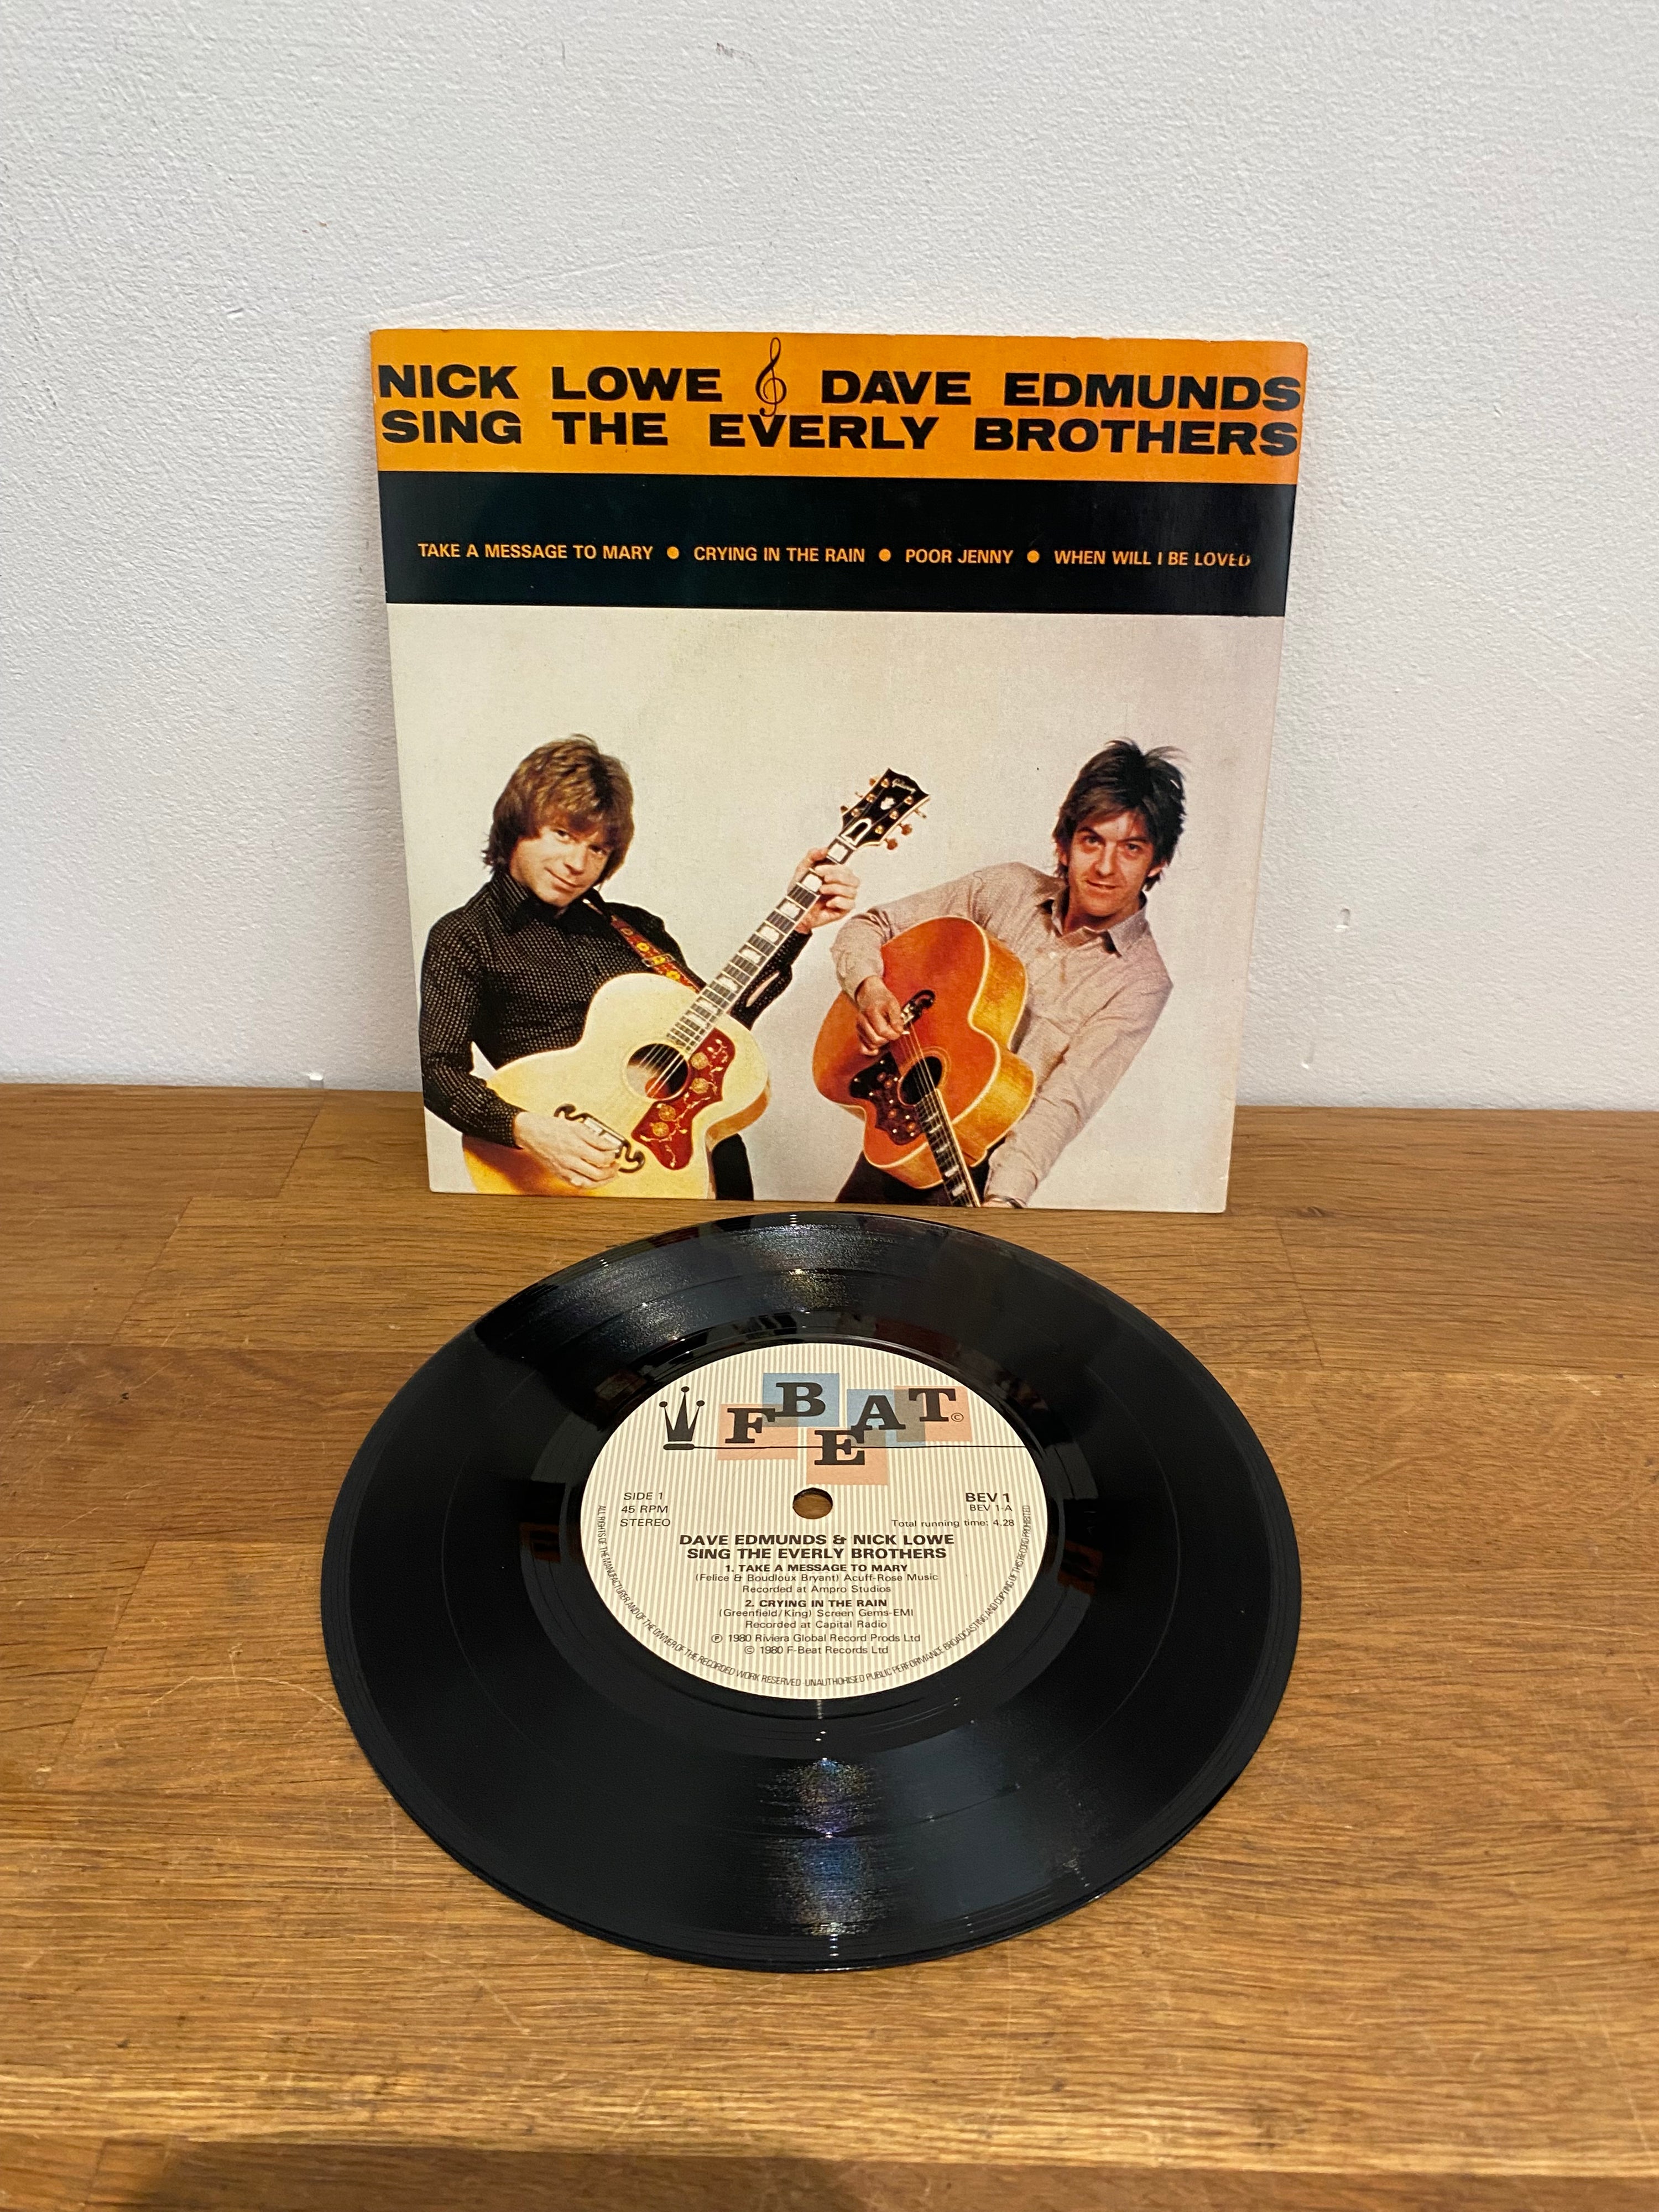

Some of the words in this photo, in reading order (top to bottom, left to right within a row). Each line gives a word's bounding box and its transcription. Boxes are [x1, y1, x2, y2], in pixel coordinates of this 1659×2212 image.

[378, 364, 519, 400] NICK
[551, 366, 722, 403] LOWE
[822, 370, 971, 405] DAVE
[1003, 372, 1302, 411] EDMUNDS
[381, 409, 522, 445] SING
[551, 411, 668, 446] THE
[709, 413, 940, 450] EVERLY
[974, 418, 1297, 456] BROTHERS
[418, 543, 461, 558] TAKE
[466, 544, 479, 558] A
[485, 544, 567, 559] MESSAGE
[573, 545, 597, 559] TO
[603, 545, 653, 560] MARY
[693, 546, 758, 561] CRYING
[763, 547, 780, 561] IN
[786, 547, 819, 562] THE
[825, 547, 865, 562] RAIN
[905, 549, 952, 564] POOR
[957, 549, 1014, 564] JENNY
[1054, 550, 1105, 565] WHEN
[1112, 551, 1151, 565] WILL
[1157, 551, 1162, 565] I
[1167, 551, 1188, 566] BE
[1194, 552, 1251, 567] LOVED
[623, 1492, 653, 1500] SIDE
[658, 1492, 663, 1500] 1
[965, 1493, 998, 1503] BEV
[1003, 1493, 1010, 1503] 1
[597, 1505, 606, 1516] ALL
[621, 1505, 635, 1514] 45
[640, 1505, 669, 1514] RPM
[597, 1516, 606, 1537] RIGHTS
[619, 1519, 671, 1527] STEREO
[921, 1519, 959, 1528] running
[598, 1537, 607, 1546] OF
[679, 1535, 729, 1545] DAVE
[734, 1534, 827, 1545] EDMUNDS
[832, 1534, 847, 1545] &
[853, 1534, 898, 1545] NICK
[903, 1533, 954, 1545] LOWE
[599, 1546, 609, 1558] THE
[687, 1548, 731, 1559] SING
[737, 1548, 771, 1559] THE
[778, 1548, 844, 1559] EVERLY
[851, 1548, 947, 1559] BROTHERS
[1018, 1538, 1030, 1560] RECORD
[1012, 1557, 1024, 1572] THIS
[602, 1557, 630, 1603] MANUFACTURER
[801, 1574, 839, 1584] Bryant)
[843, 1573, 902, 1582] Acuff-Rose
[906, 1573, 938, 1581] Music
[1008, 1571, 1018, 1582] OF
[811, 1585, 847, 1594] Ampro
[994, 1580, 1014, 1605] COPYING
[626, 1602, 640, 1615] AND
[719, 1609, 812, 1619] (Greenfield/King)
[858, 1608, 914, 1616] Gems-EMI
[984, 1603, 998, 1618] AND
[635, 1611, 646, 1621] OF
[642, 1618, 657, 1631] THE
[816, 1620, 852, 1629] Capital
[857, 1620, 888, 1628] Radio
[653, 1627, 677, 1648] OWNER
[728, 1634, 752, 1642] 1980
[755, 1634, 790, 1642] Riviera
[793, 1634, 826, 1642] Global
[830, 1634, 867, 1642] Record
[870, 1634, 900, 1642] Prods
[904, 1634, 921, 1642] Ltd
[942, 1614, 989, 1651] BROADCASTING
[675, 1643, 685, 1652] OF
[760, 1646, 784, 1654] 1980
[787, 1646, 822, 1654] F-Beat
[825, 1646, 868, 1654] Records
[872, 1646, 888, 1654] Ltd
[685, 1648, 699, 1660] THE
[892, 1646, 945, 1673] PERFORMANCE
[697, 1655, 735, 1675] RECORDED
[735, 1669, 760, 1681] WORK
[761, 1674, 801, 1686] RESERVED
[865, 1668, 893, 1681] PUBLIC
